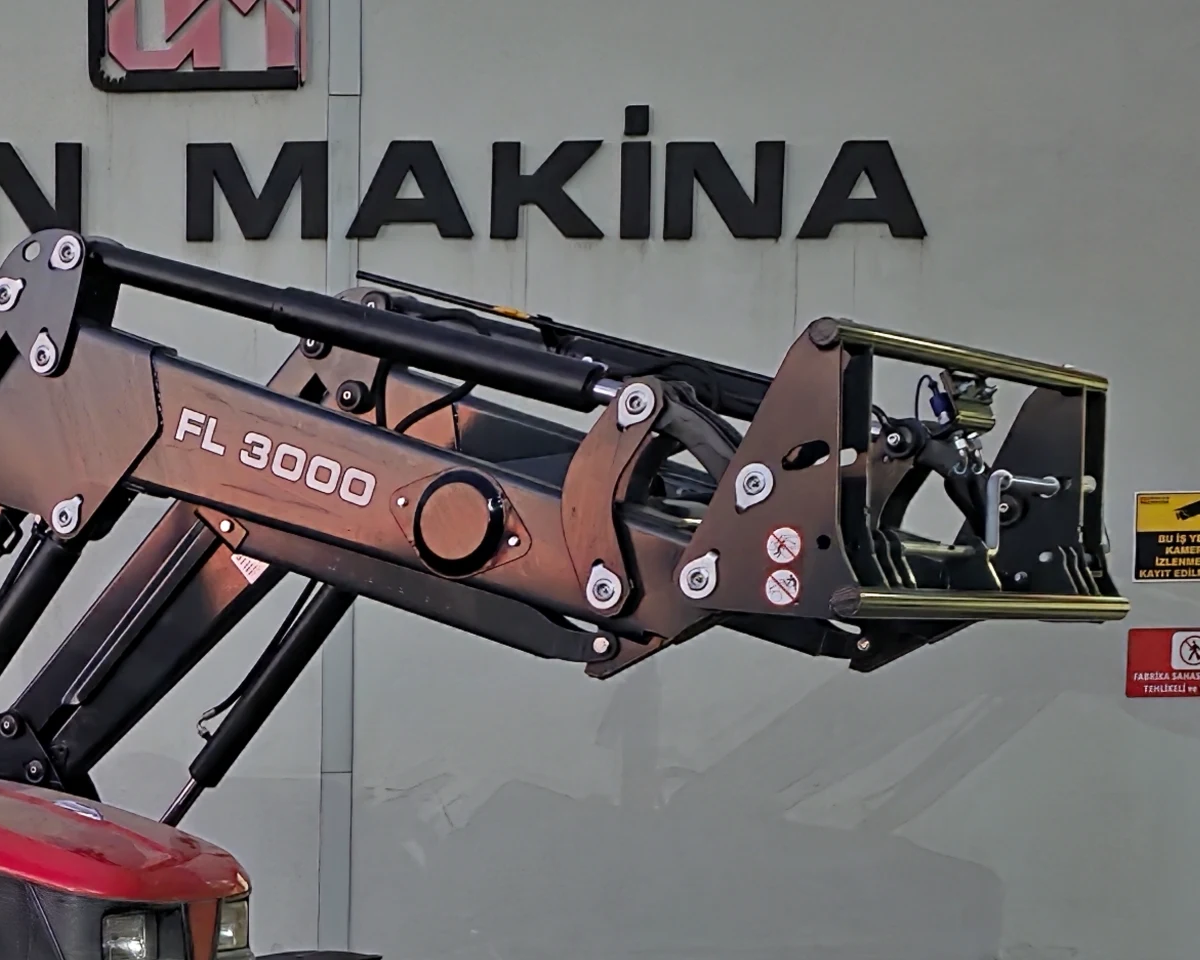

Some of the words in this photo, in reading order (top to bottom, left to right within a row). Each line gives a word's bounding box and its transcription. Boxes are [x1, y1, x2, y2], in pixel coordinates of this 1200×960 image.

[186, 104, 928, 242] MAKİNA
[174, 406, 227, 457] FL
[238, 430, 377, 507] 3000
[1157, 533, 1174, 543] BU
[1176, 532, 1187, 545] İŞ
[1155, 556, 1200, 567] İZLENME
[1139, 569, 1172, 578] KAYIT
[1133, 671, 1170, 681] FABRİKA
[1143, 682, 1186, 693] TEHLİKELİ
